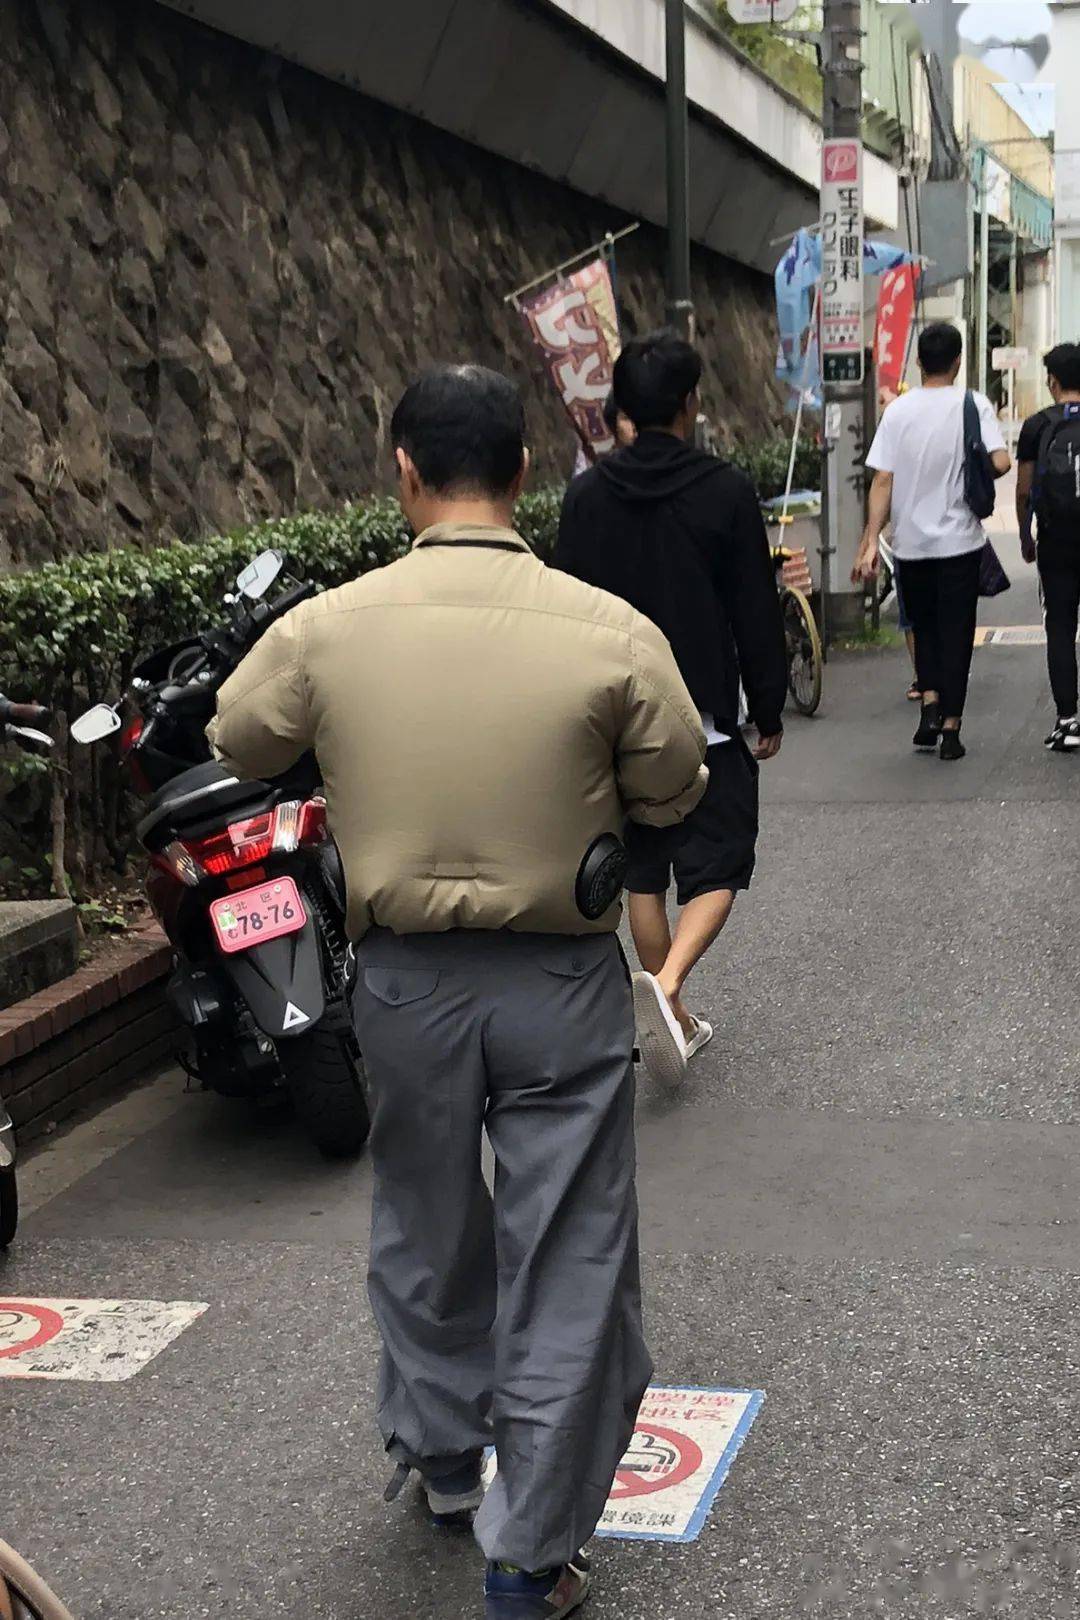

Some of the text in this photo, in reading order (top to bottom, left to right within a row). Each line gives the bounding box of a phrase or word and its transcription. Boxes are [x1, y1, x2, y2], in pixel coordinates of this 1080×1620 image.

[822, 211, 838, 296] クリニック
[838, 187, 859, 282] 王子眼科
[236, 900, 294, 935] 78-76
